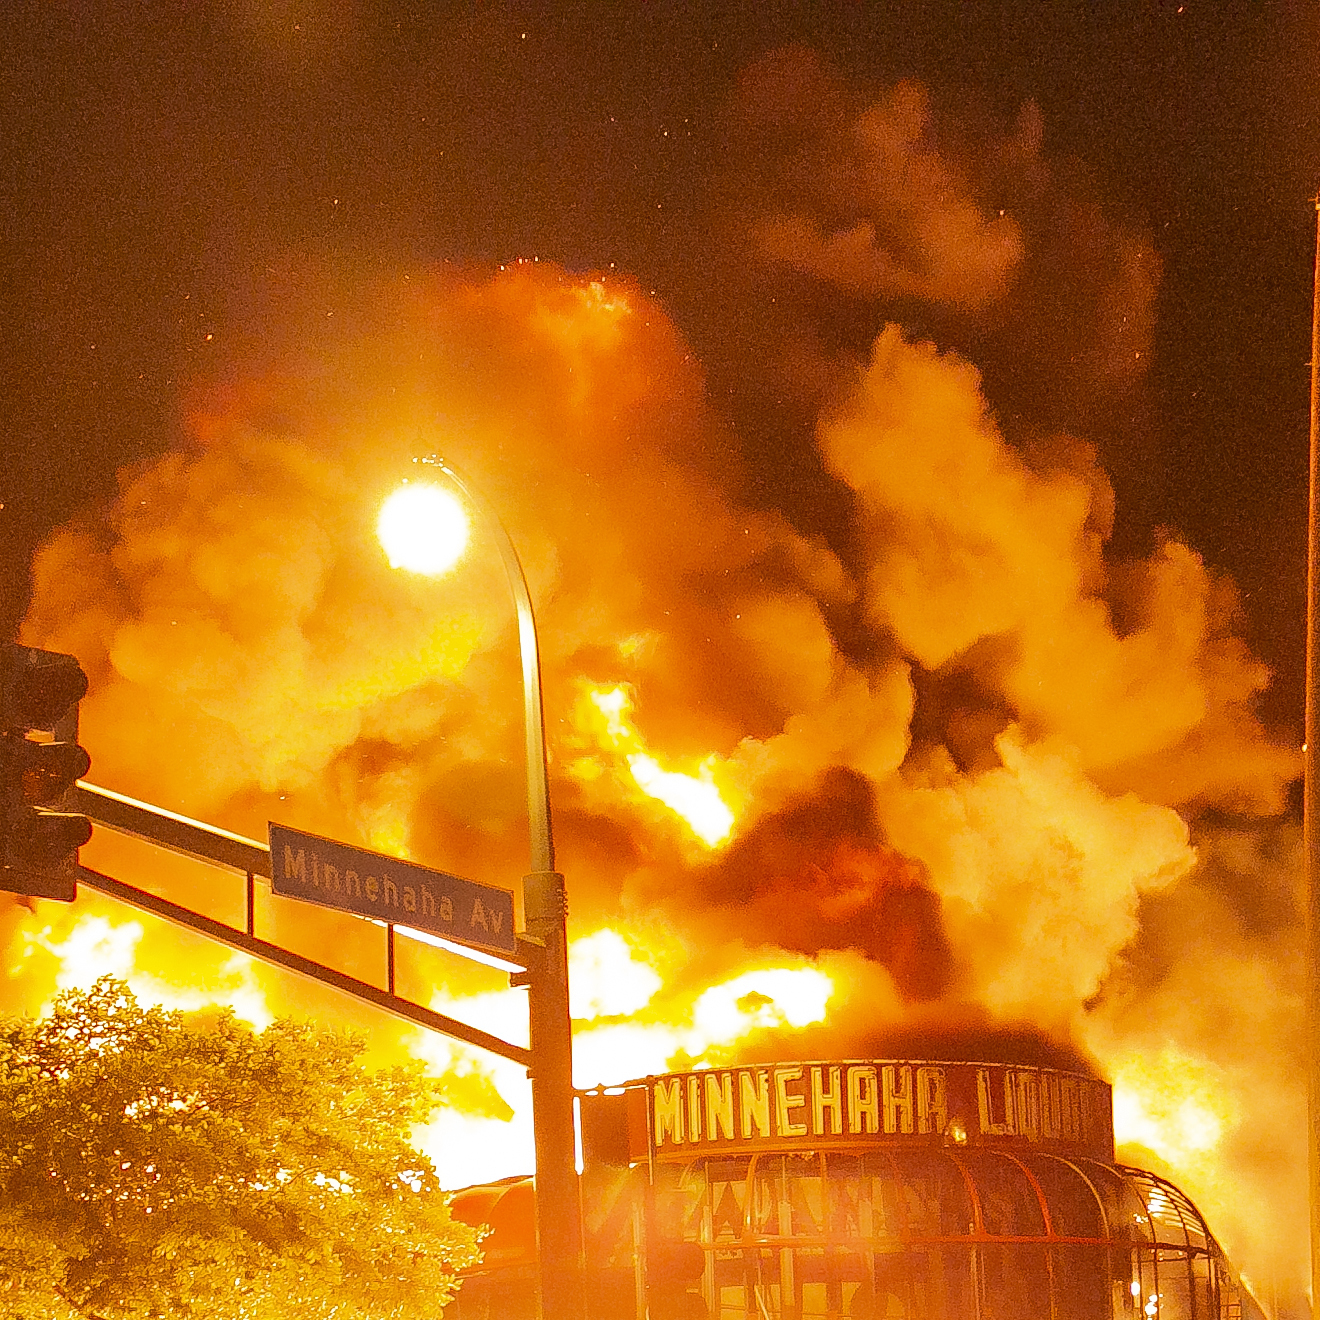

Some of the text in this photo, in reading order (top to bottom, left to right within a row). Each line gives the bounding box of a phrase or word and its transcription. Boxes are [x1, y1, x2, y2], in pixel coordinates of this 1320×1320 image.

[283, 844, 504, 935] Minnehaha Av
[654, 1065, 1093, 1147] MINNEHAHA LIQUO
